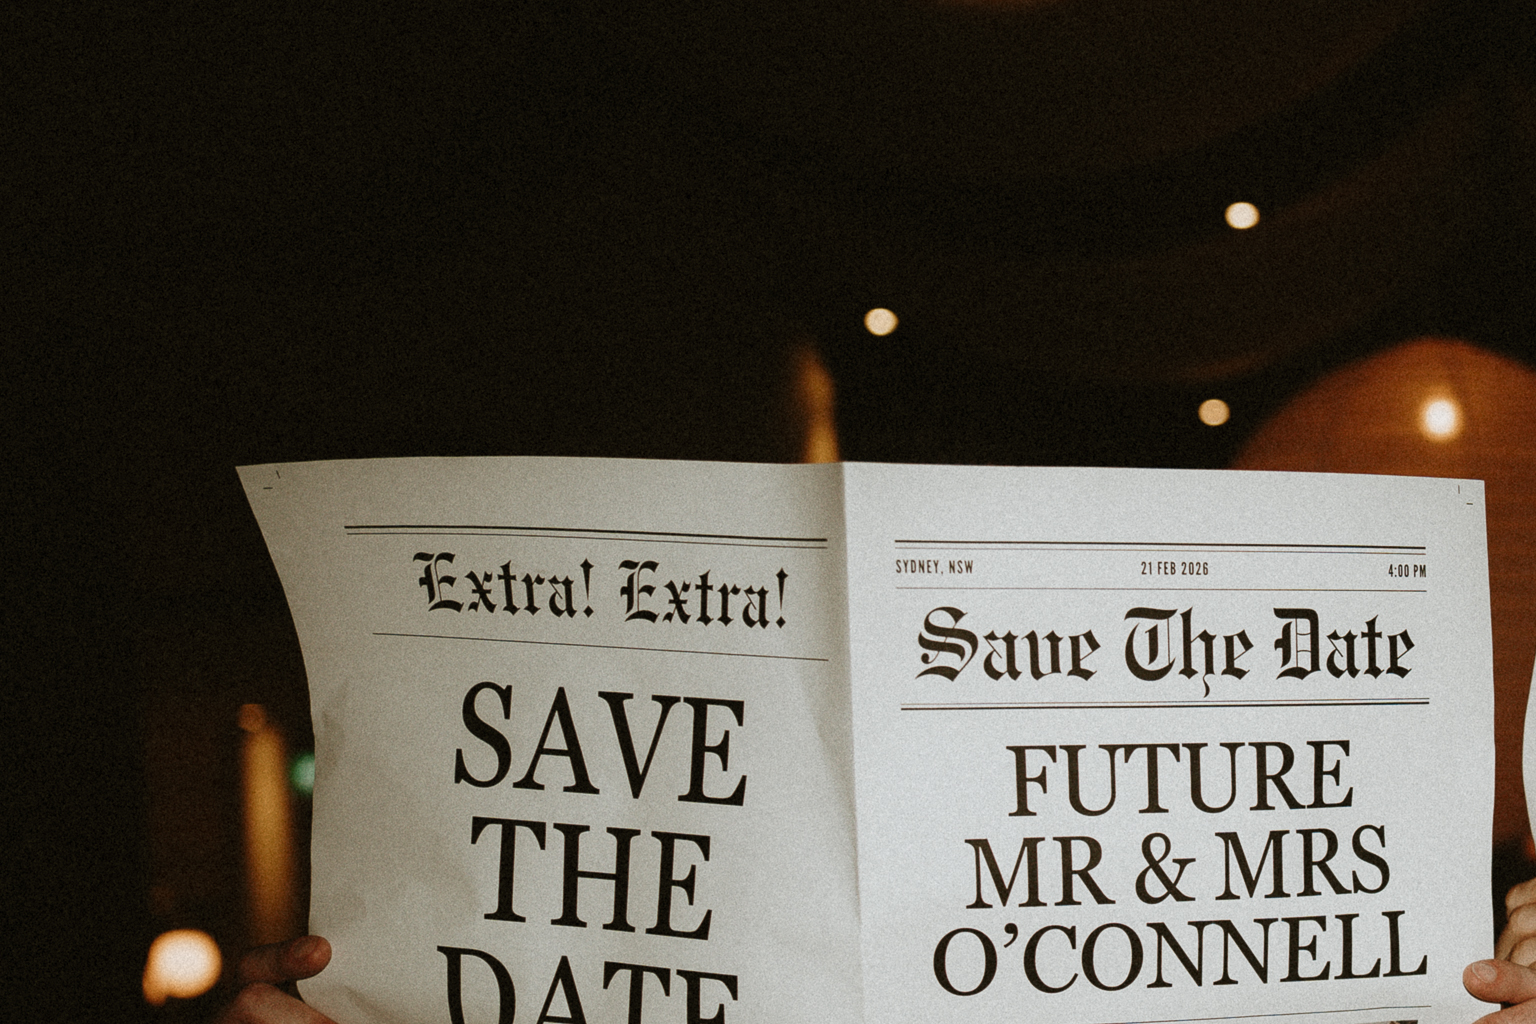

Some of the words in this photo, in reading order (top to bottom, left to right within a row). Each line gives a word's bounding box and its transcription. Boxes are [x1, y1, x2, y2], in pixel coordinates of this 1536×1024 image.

[413, 552, 594, 618] Extra!
[618, 560, 788, 629] Extra!
[895, 560, 944, 575] SYDNEY,
[949, 560, 973, 574] NSW
[1141, 561, 1152, 575] 21
[1157, 561, 1176, 575] FEB
[1181, 562, 1208, 575] 2026
[1388, 564, 1409, 577] 4:00
[1413, 564, 1426, 577] PM
[916, 606, 1101, 682] Save
[1124, 607, 1254, 698] The
[1273, 608, 1415, 680] Date
[454, 681, 747, 807] SAVE
[1006, 739, 1353, 817] FUTURE
[471, 816, 712, 941] THE
[964, 836, 1116, 909] MR
[1135, 832, 1196, 905] &
[1214, 824, 1390, 901] MRS
[933, 910, 1428, 997] O'CONNELL
